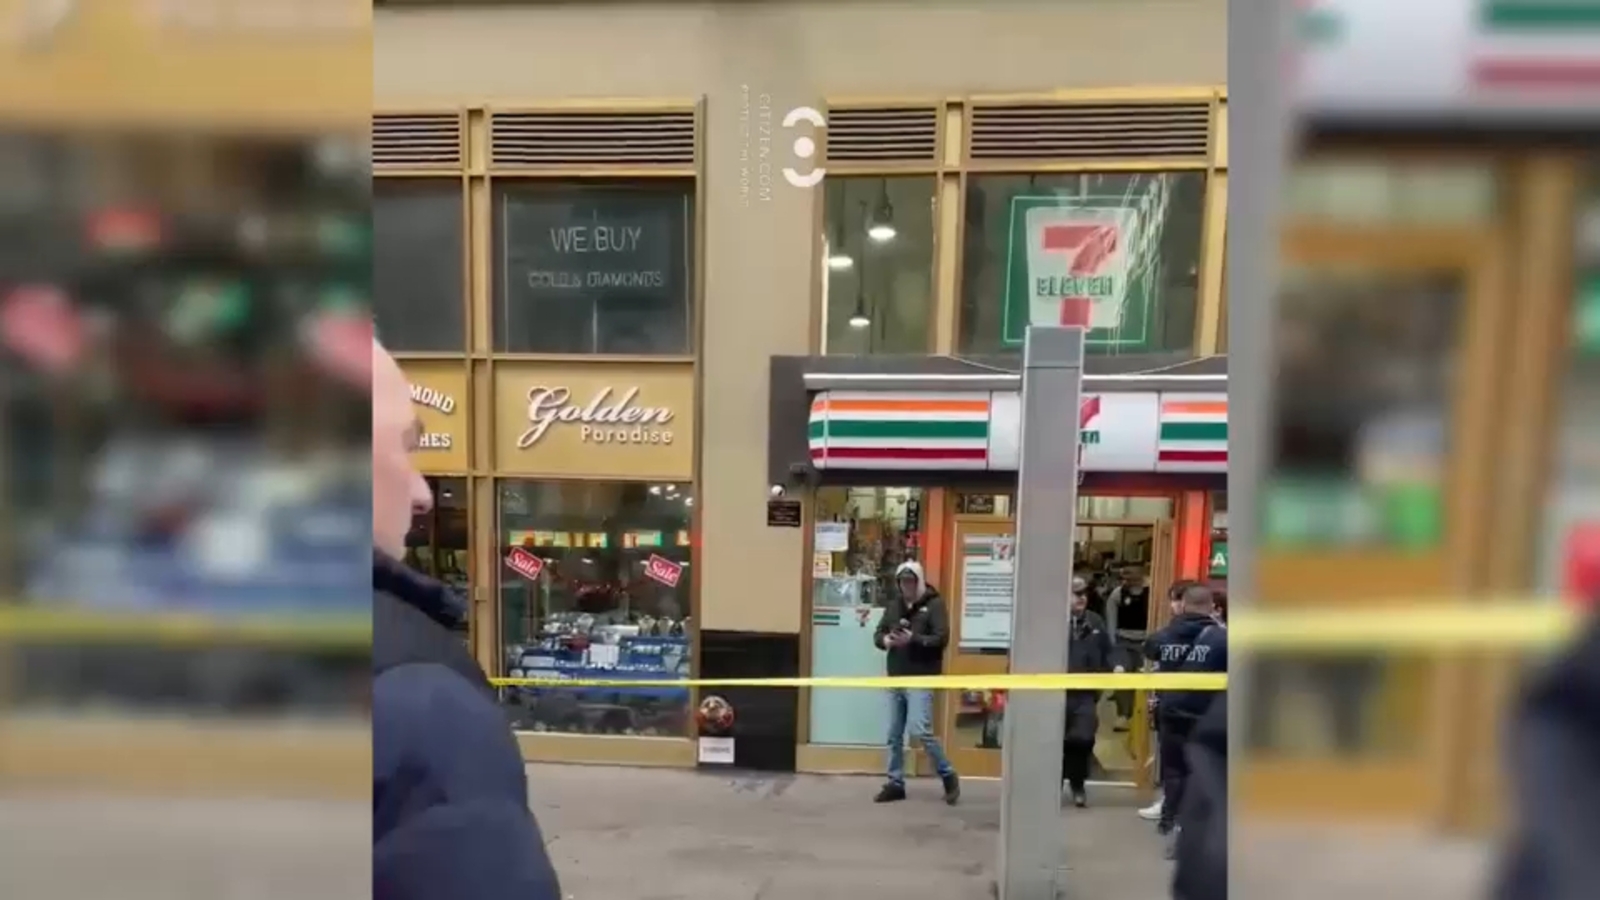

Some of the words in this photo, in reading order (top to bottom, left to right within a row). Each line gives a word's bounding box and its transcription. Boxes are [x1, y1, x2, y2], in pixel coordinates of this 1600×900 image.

[550, 226, 587, 252] WE
[594, 226, 642, 251] BUY
[586, 271, 664, 288] DIAMONDS
[516, 385, 675, 449] Golden
[581, 427, 674, 445] Paradise
[510, 551, 539, 575] Sale
[1211, 552, 1228, 567] A
[650, 561, 679, 583] Sale
